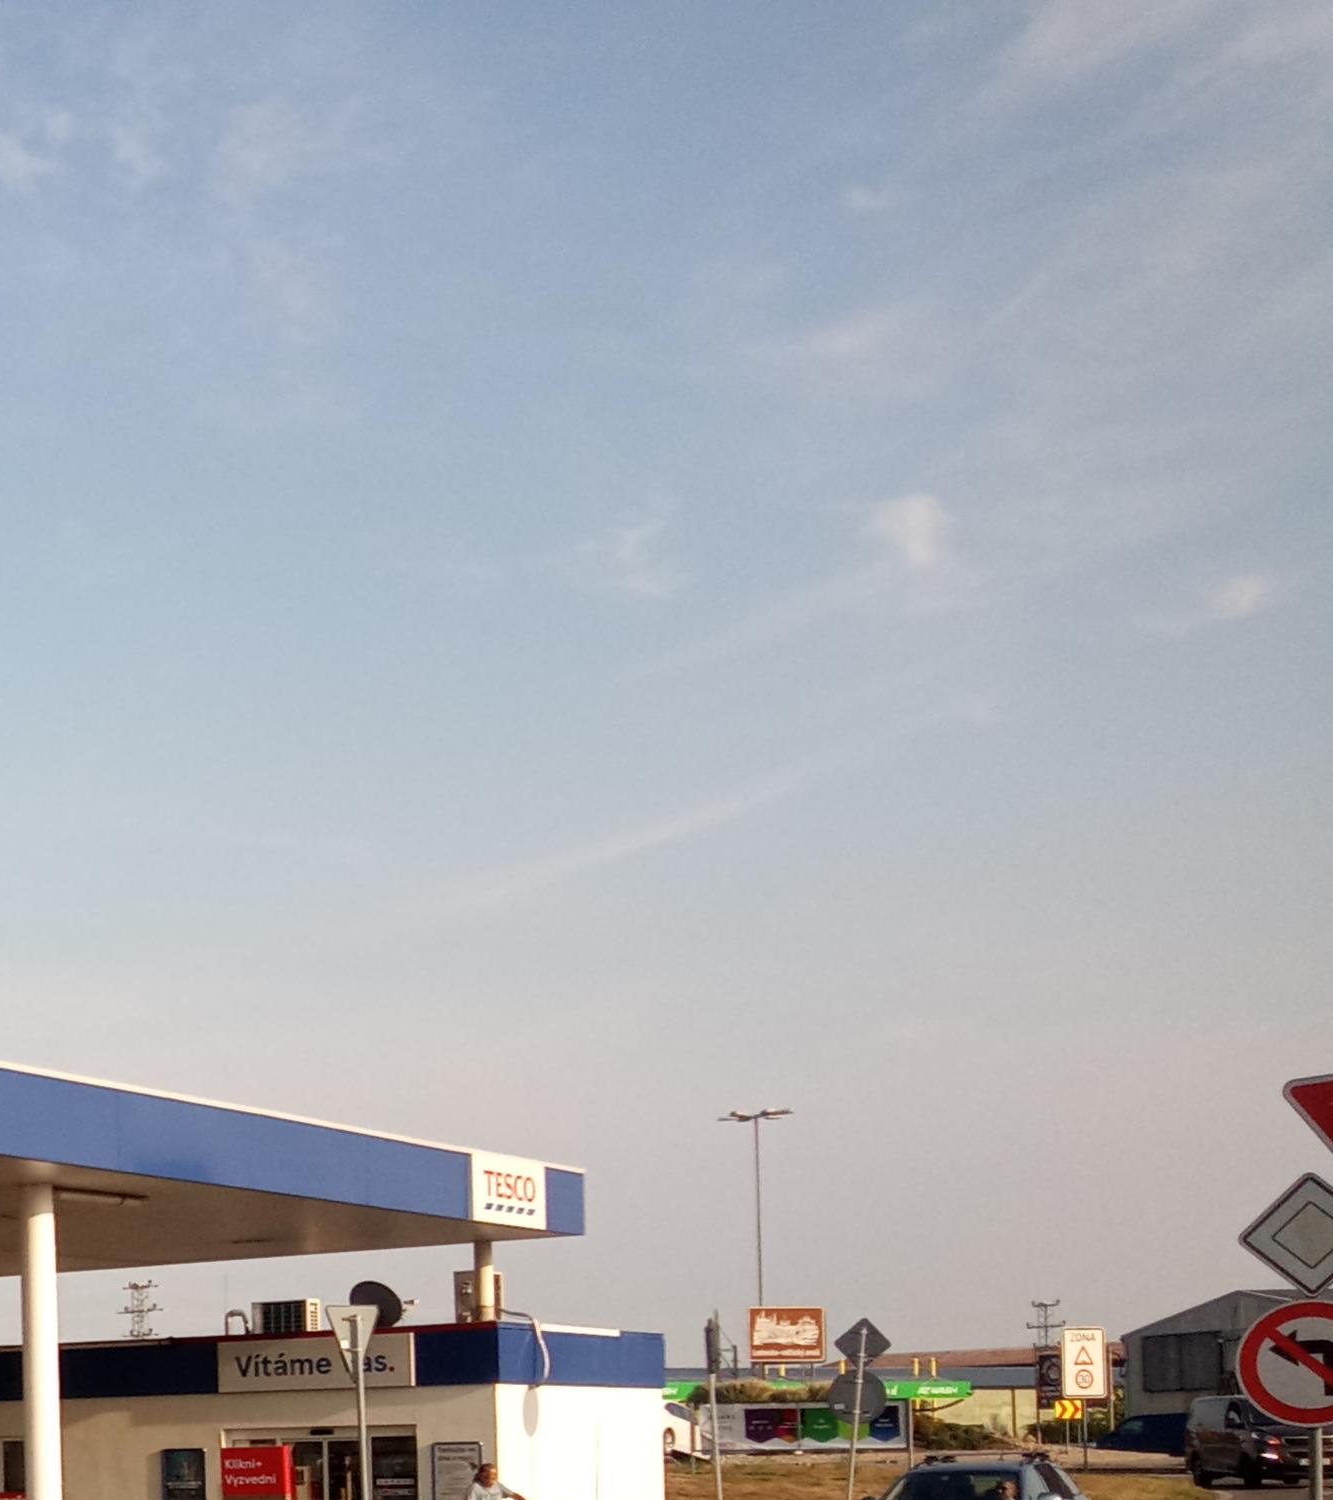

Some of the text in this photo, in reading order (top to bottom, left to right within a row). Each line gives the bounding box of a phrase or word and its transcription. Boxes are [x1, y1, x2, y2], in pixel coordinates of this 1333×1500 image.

[484, 1170, 536, 1203] TESCO
[1070, 1332, 1096, 1342] ZONA
[235, 1352, 332, 1378] Vítáme
[225, 1474, 277, 1487] Vyzvedni
